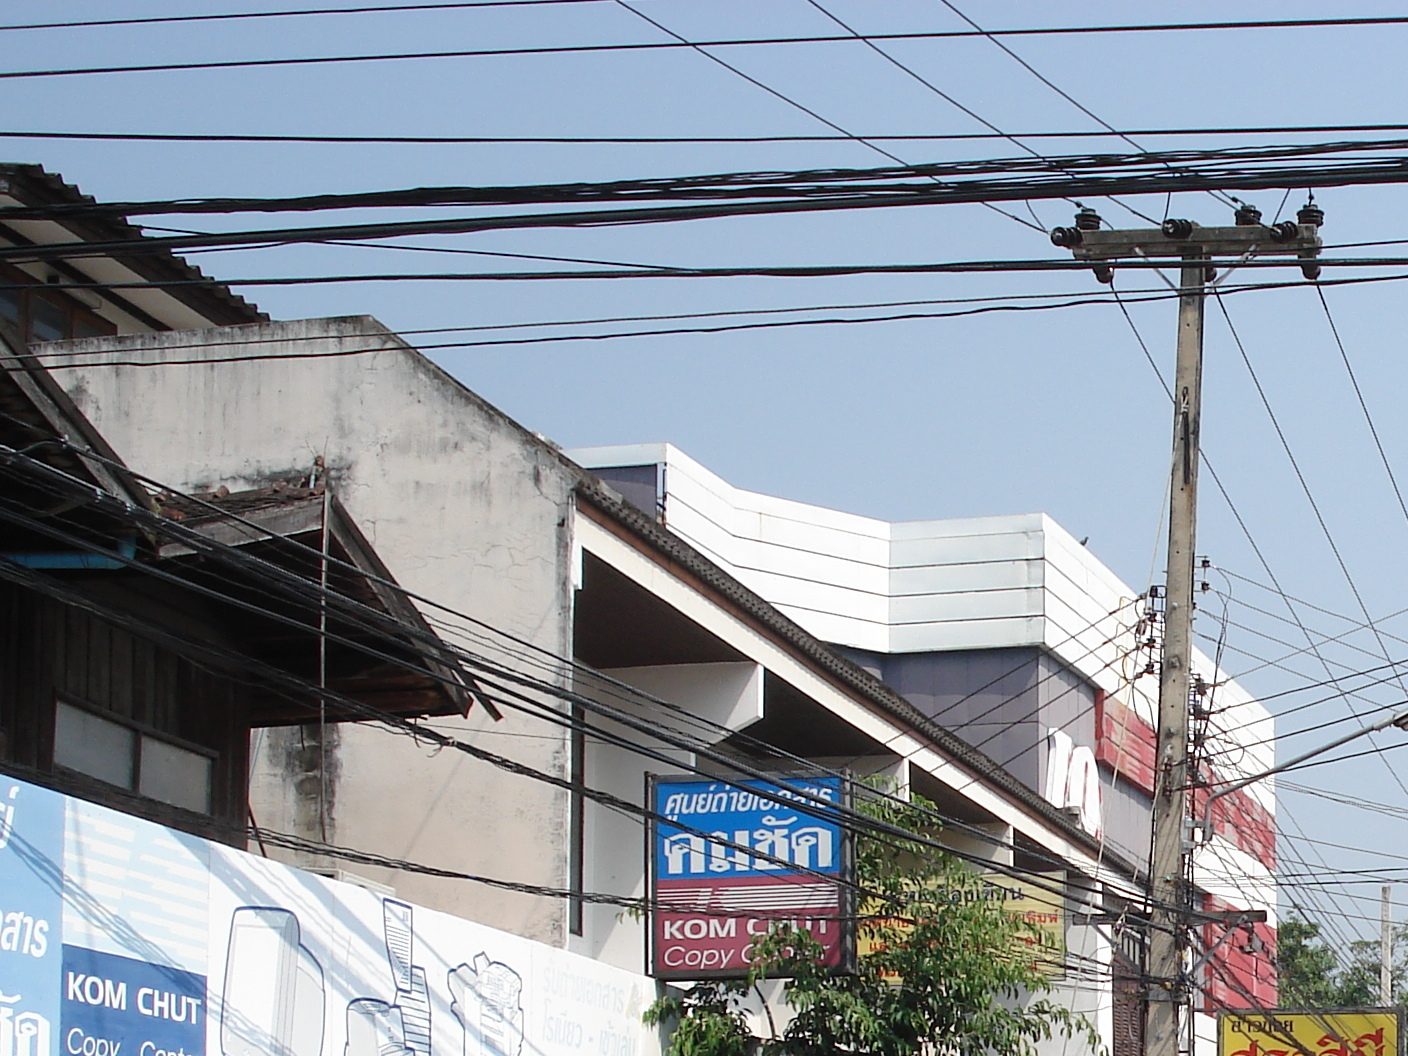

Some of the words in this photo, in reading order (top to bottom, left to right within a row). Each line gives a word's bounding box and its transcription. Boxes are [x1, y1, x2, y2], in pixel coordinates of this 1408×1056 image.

[664, 814, 833, 875] คมชัด
[663, 918, 737, 940] KOM
[663, 946, 736, 969] Copy
[67, 971, 128, 1011] KOM
[136, 986, 202, 1026] CHUT
